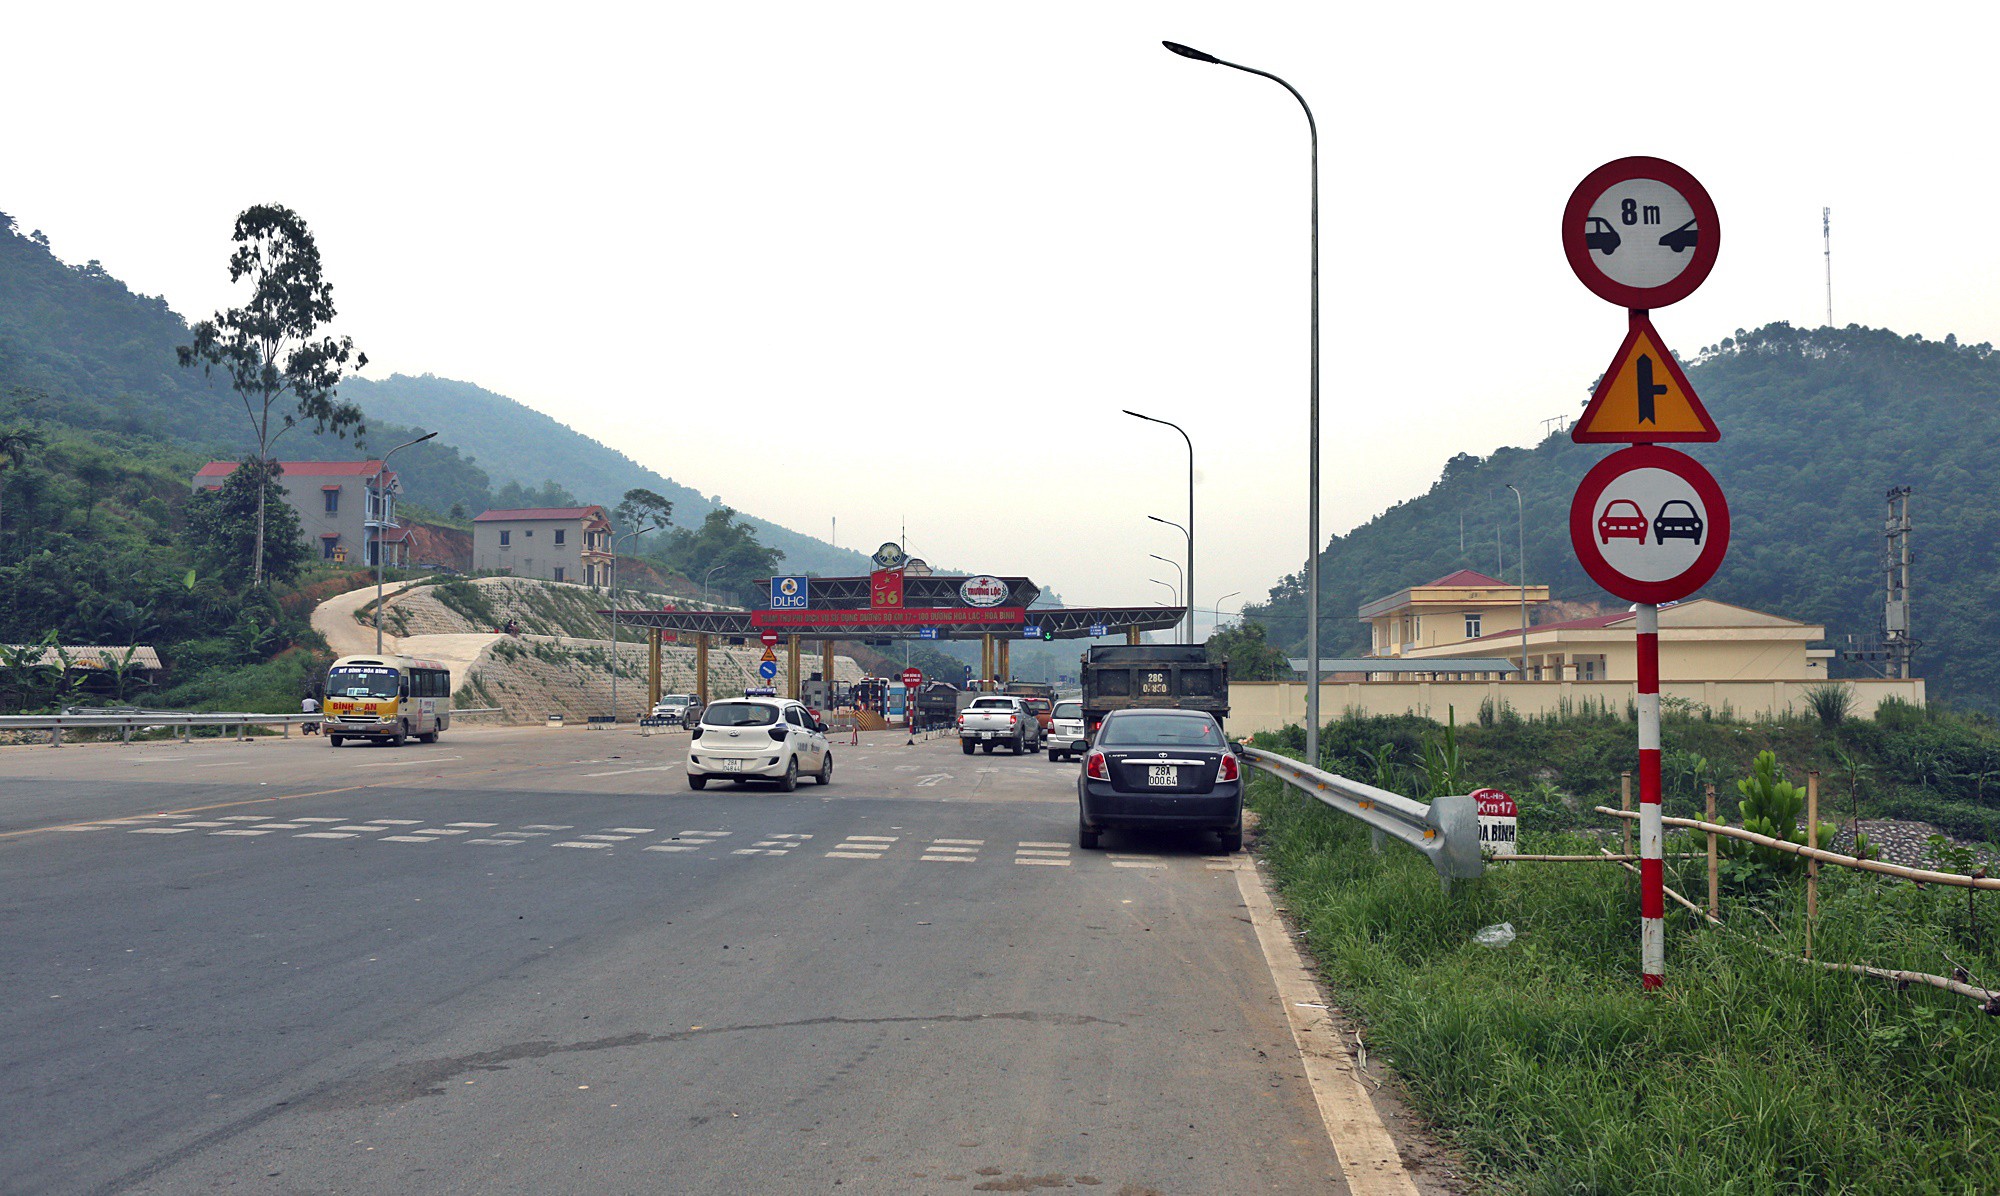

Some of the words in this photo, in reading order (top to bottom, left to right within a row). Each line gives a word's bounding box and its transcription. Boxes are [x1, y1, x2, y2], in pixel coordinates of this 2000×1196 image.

[1621, 198, 1638, 226] 8
[1643, 205, 1661, 225] m
[990, 586, 1001, 598] LỘC
[773, 596, 805, 607] DLHC
[876, 591, 899, 605] 36
[1000, 610, 1015, 620] BÌNH
[1148, 673, 1163, 682] 28C
[333, 702, 354, 710] BÌNH
[1155, 767, 1170, 776] 28A
[1150, 776, 1176, 785] 000.64
[1492, 821, 1515, 841] BÌNH
